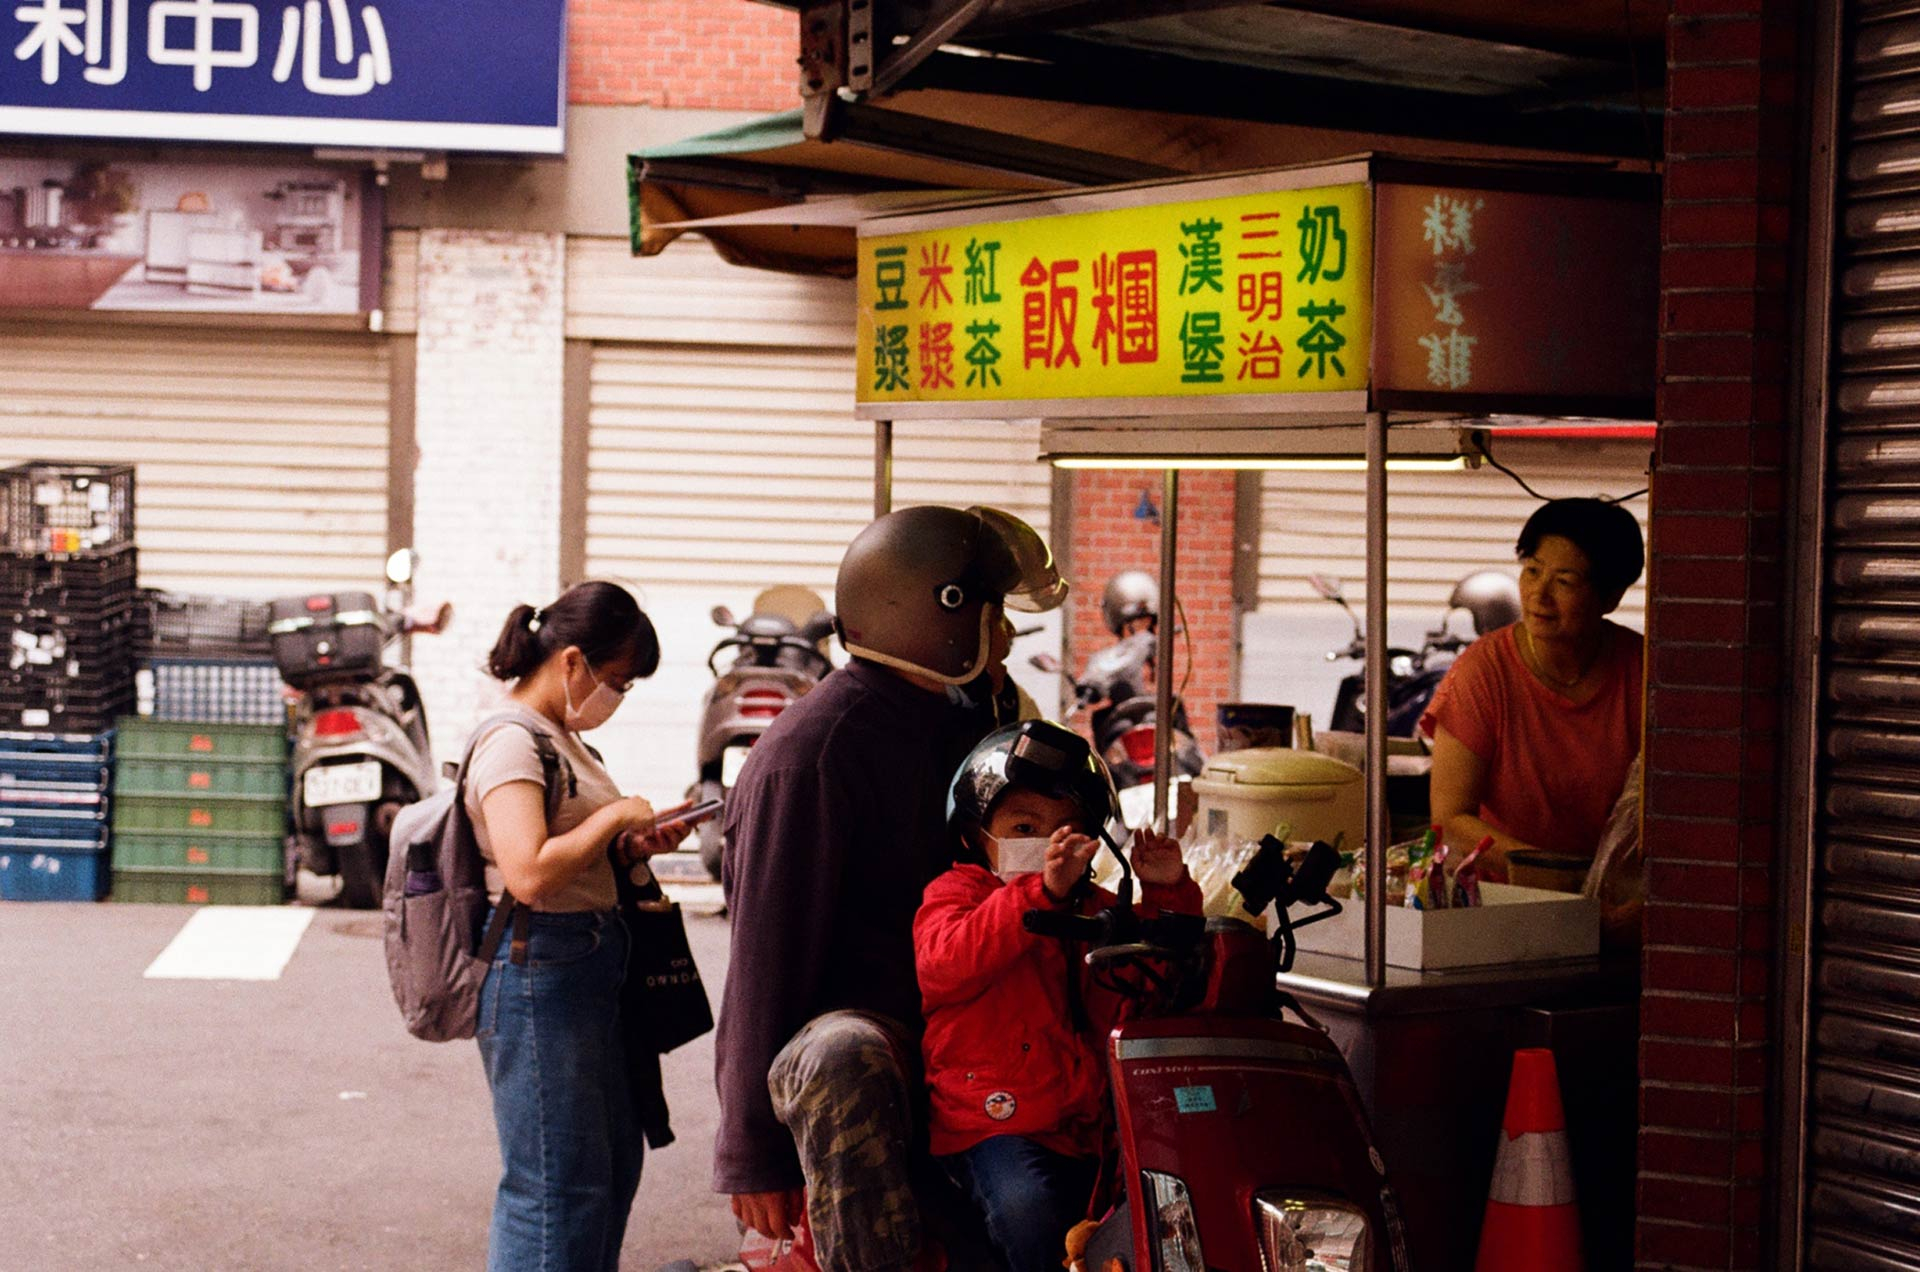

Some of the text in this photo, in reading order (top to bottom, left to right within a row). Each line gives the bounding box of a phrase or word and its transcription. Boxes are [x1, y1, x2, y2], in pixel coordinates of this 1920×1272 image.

[14, 0, 392, 96] 利中心
[874, 245, 910, 392] 豆漿
[918, 239, 955, 390] 米漿
[964, 236, 1002, 389] 紅茶
[1019, 248, 1159, 371] 飯糰
[1178, 216, 1225, 384] 漢堡
[1237, 211, 1284, 382] 三明治
[1296, 204, 1348, 380] 奶茶
